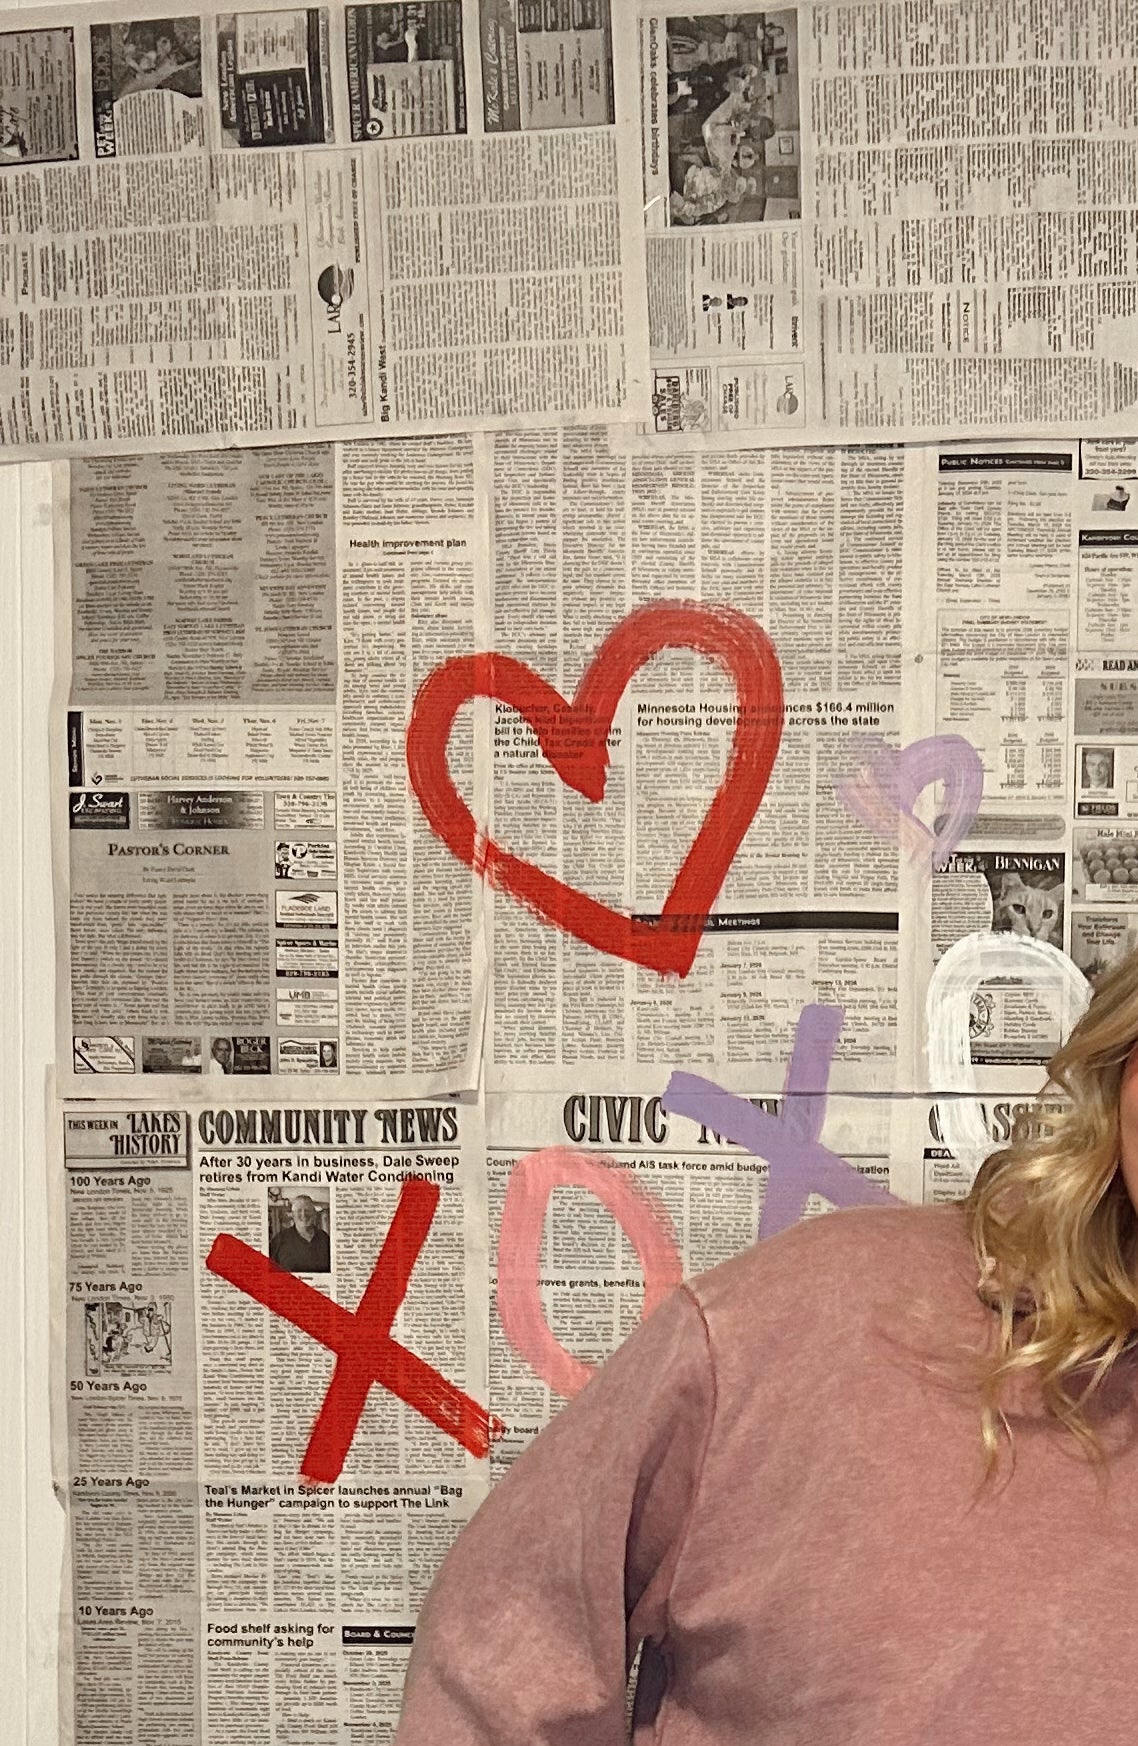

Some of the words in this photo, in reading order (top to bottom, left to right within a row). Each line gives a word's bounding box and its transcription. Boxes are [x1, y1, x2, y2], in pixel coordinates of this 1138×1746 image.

[348, 538, 380, 548] Health
[381, 539, 444, 552] improvement
[445, 538, 466, 549] plan
[637, 703, 696, 714] Minnesota
[698, 702, 747, 715] Housing
[855, 701, 894, 712] million
[637, 716, 654, 728] for
[656, 716, 702, 729] housing
[788, 716, 827, 726] across
[829, 715, 849, 726] the
[851, 715, 880, 726] state
[67, 1119, 86, 1130] THIS
[86, 1119, 109, 1130] WEEK
[109, 1119, 118, 1129] IN
[125, 1111, 180, 1135] LAKES
[198, 1109, 366, 1144] COMMUNITY
[374, 1106, 458, 1143] NEWS
[562, 1094, 667, 1145] CIVIC
[109, 1133, 180, 1155] HISTORY
[198, 1155, 232, 1168] After
[236, 1155, 252, 1167] 30
[255, 1157, 292, 1170] years
[296, 1155, 309, 1167] in
[313, 1155, 378, 1168] business,
[382, 1154, 412, 1167] Dale
[415, 1154, 459, 1168] Sweep
[69, 1175, 90, 1187] 100
[92, 1175, 124, 1186] Years
[126, 1175, 151, 1188] Ago
[199, 1171, 242, 1183] retires
[245, 1169, 278, 1182] from
[281, 1170, 321, 1182] Kandi
[325, 1170, 364, 1182] Water
[367, 1169, 454, 1185] Conditioning
[68, 1281, 82, 1292] 75
[84, 1281, 116, 1292] Years
[118, 1280, 142, 1293] Ago
[69, 1380, 84, 1391] 50
[85, 1380, 120, 1391] Years
[122, 1380, 147, 1394] Ago
[72, 1475, 87, 1487] 25
[89, 1476, 123, 1487] Years
[124, 1476, 150, 1489] Ago
[203, 1484, 238, 1495] Teal's
[240, 1484, 281, 1495] Market
[283, 1484, 294, 1495] in
[297, 1482, 335, 1497] Spicer
[337, 1485, 390, 1495] launches
[392, 1485, 431, 1495] annual
[204, 1497, 224, 1508] the
[278, 1498, 335, 1510] campaign
[337, 1498, 350, 1508] to
[352, 1498, 398, 1510] support
[399, 1497, 422, 1508] The
[424, 1497, 449, 1508] Link
[78, 1605, 92, 1616] 10
[94, 1605, 127, 1616] Years
[129, 1605, 154, 1618] Ago
[206, 1622, 238, 1634] Food
[240, 1622, 271, 1634] shelf
[273, 1622, 314, 1636] asking
[316, 1622, 335, 1634] for
[206, 1636, 284, 1649] community's
[287, 1636, 314, 1649] help
